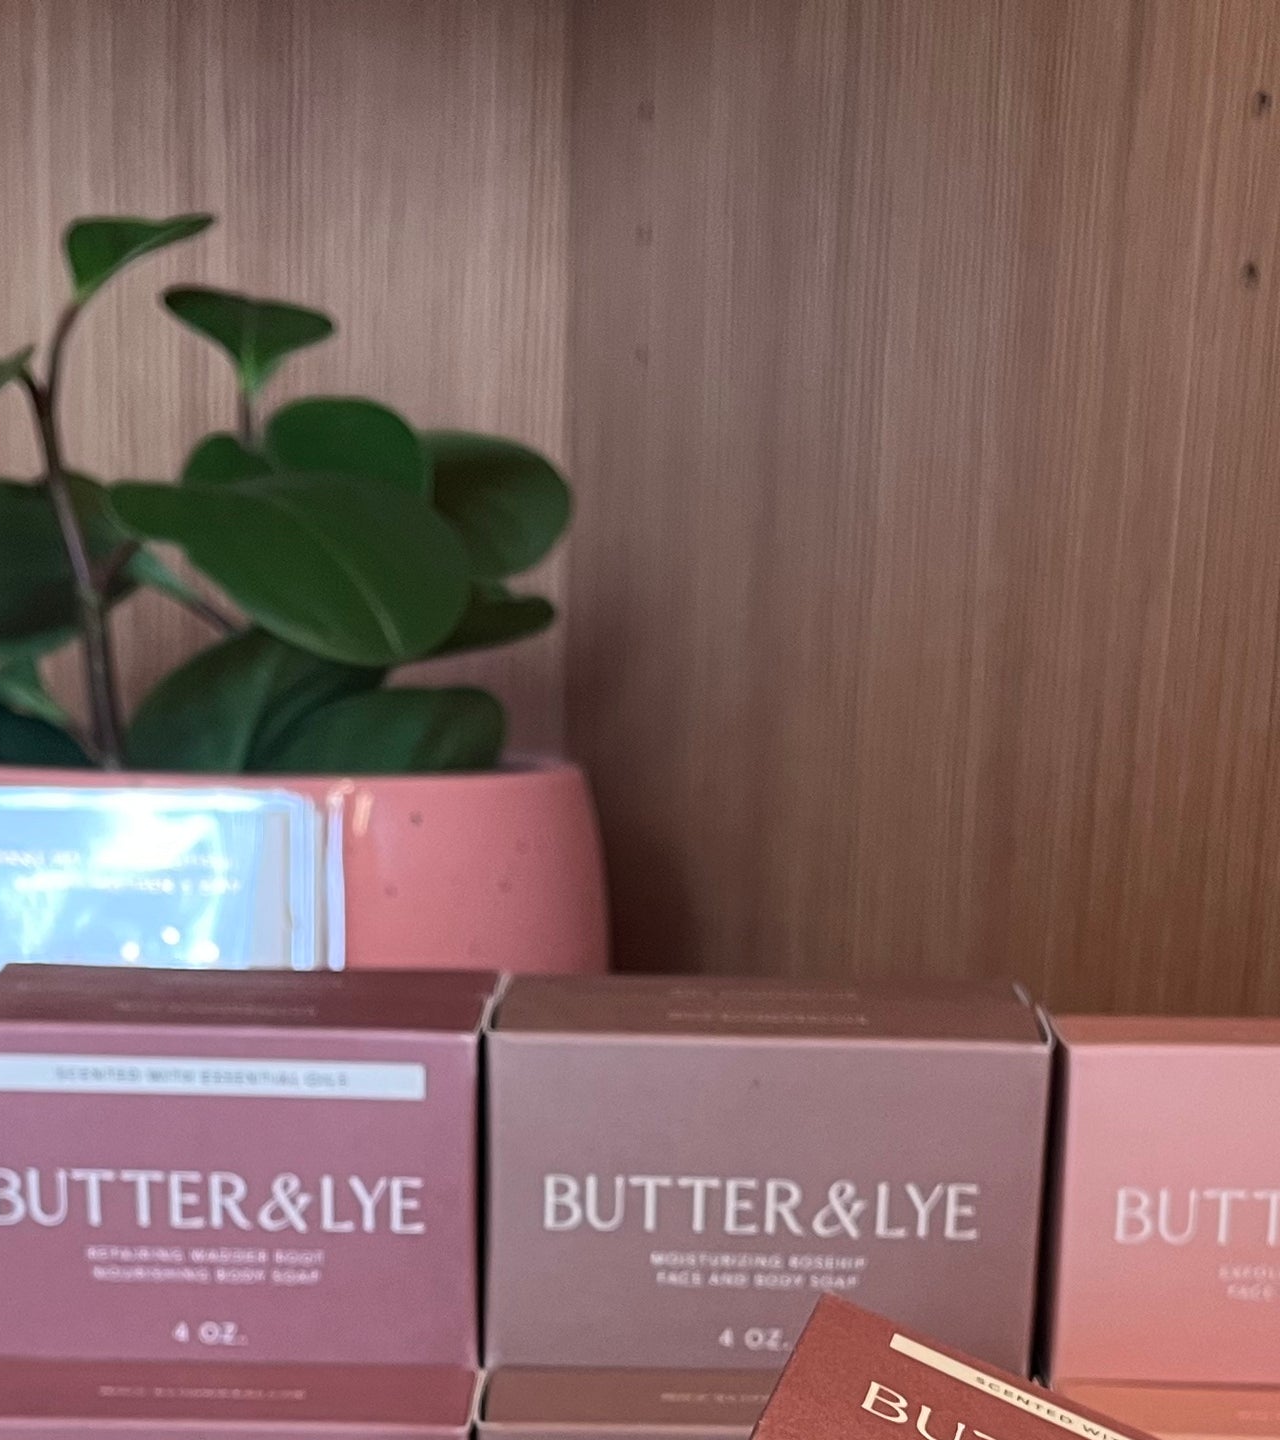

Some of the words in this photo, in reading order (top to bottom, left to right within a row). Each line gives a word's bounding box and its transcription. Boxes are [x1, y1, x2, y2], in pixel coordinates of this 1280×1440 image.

[173, 1320, 191, 1343] 4
[719, 1326, 734, 1347] 4
[975, 1375, 1074, 1426] SCENTED
